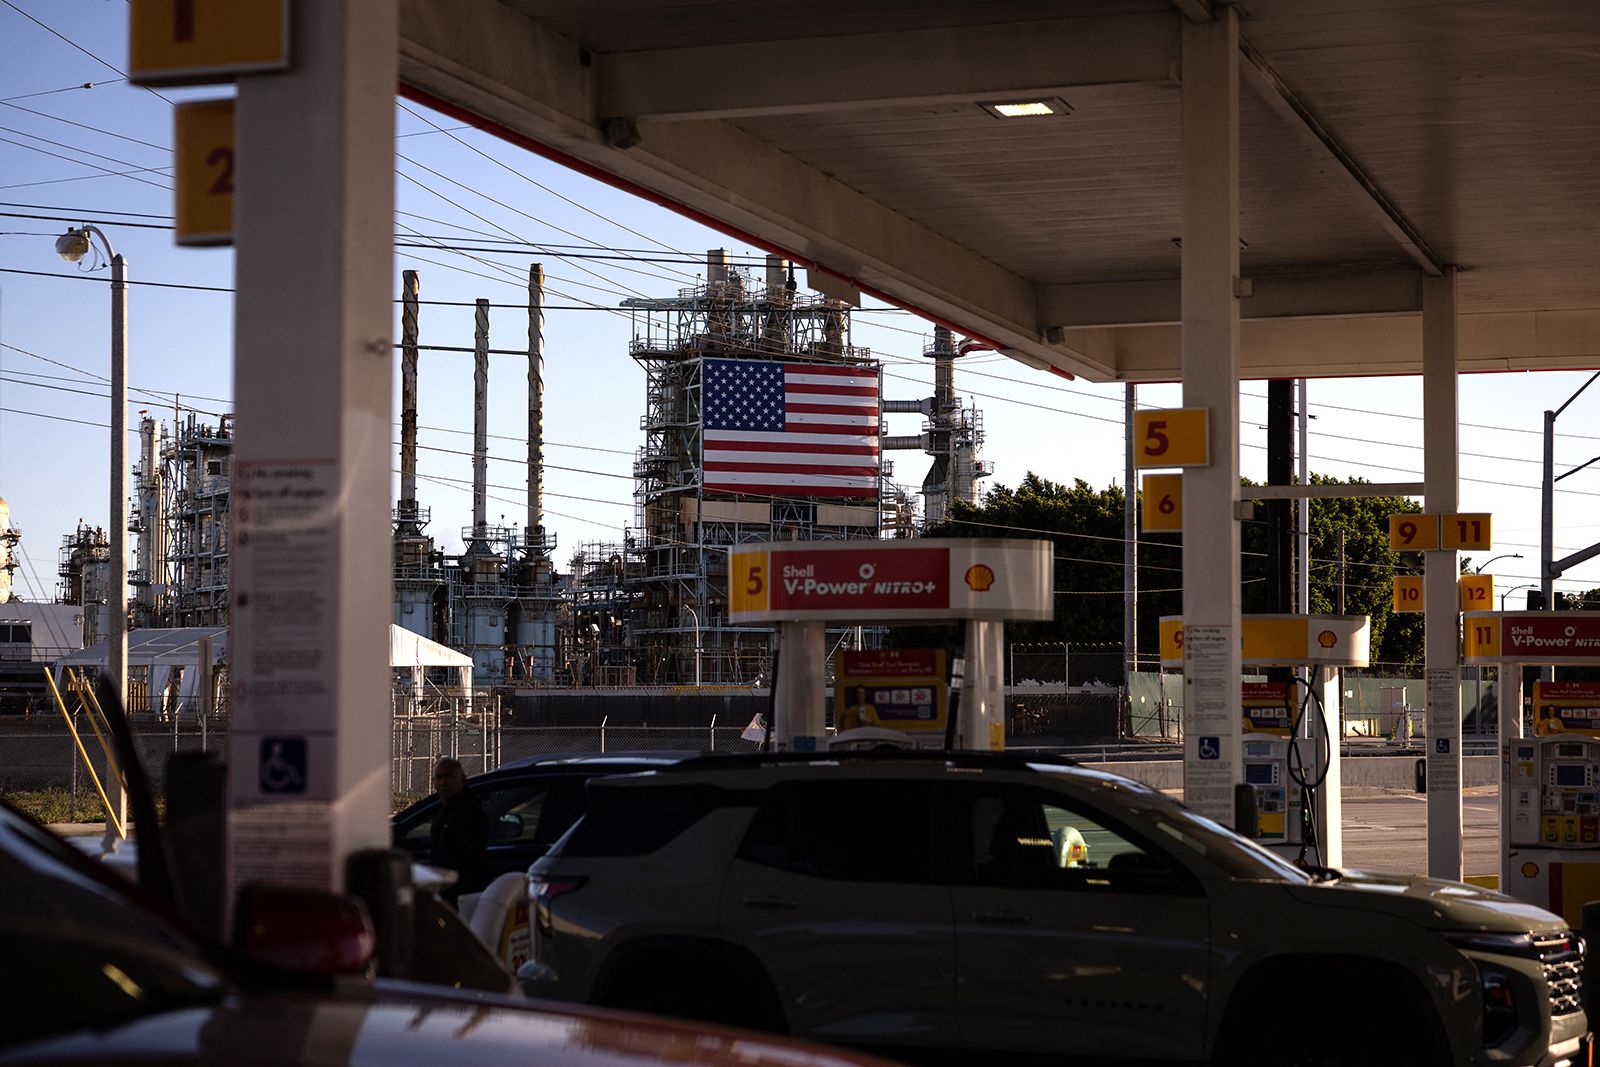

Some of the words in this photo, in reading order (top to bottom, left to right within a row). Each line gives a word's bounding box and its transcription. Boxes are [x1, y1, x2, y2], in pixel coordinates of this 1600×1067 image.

[207, 147, 235, 194] 2
[1144, 421, 1169, 456] 5
[1158, 495, 1175, 514] 6
[1399, 522, 1417, 544] 9
[1457, 521, 1480, 543] 11
[783, 565, 814, 577] Shell
[747, 567, 763, 595] 5
[784, 579, 867, 595] V-Power
[1401, 588, 1419, 600] 10
[1468, 588, 1485, 600] 12
[1476, 626, 1491, 644] 11
[1511, 626, 1533, 635] Shell
[1174, 630, 1184, 650] 9
[1512, 636, 1571, 647] V-Power
